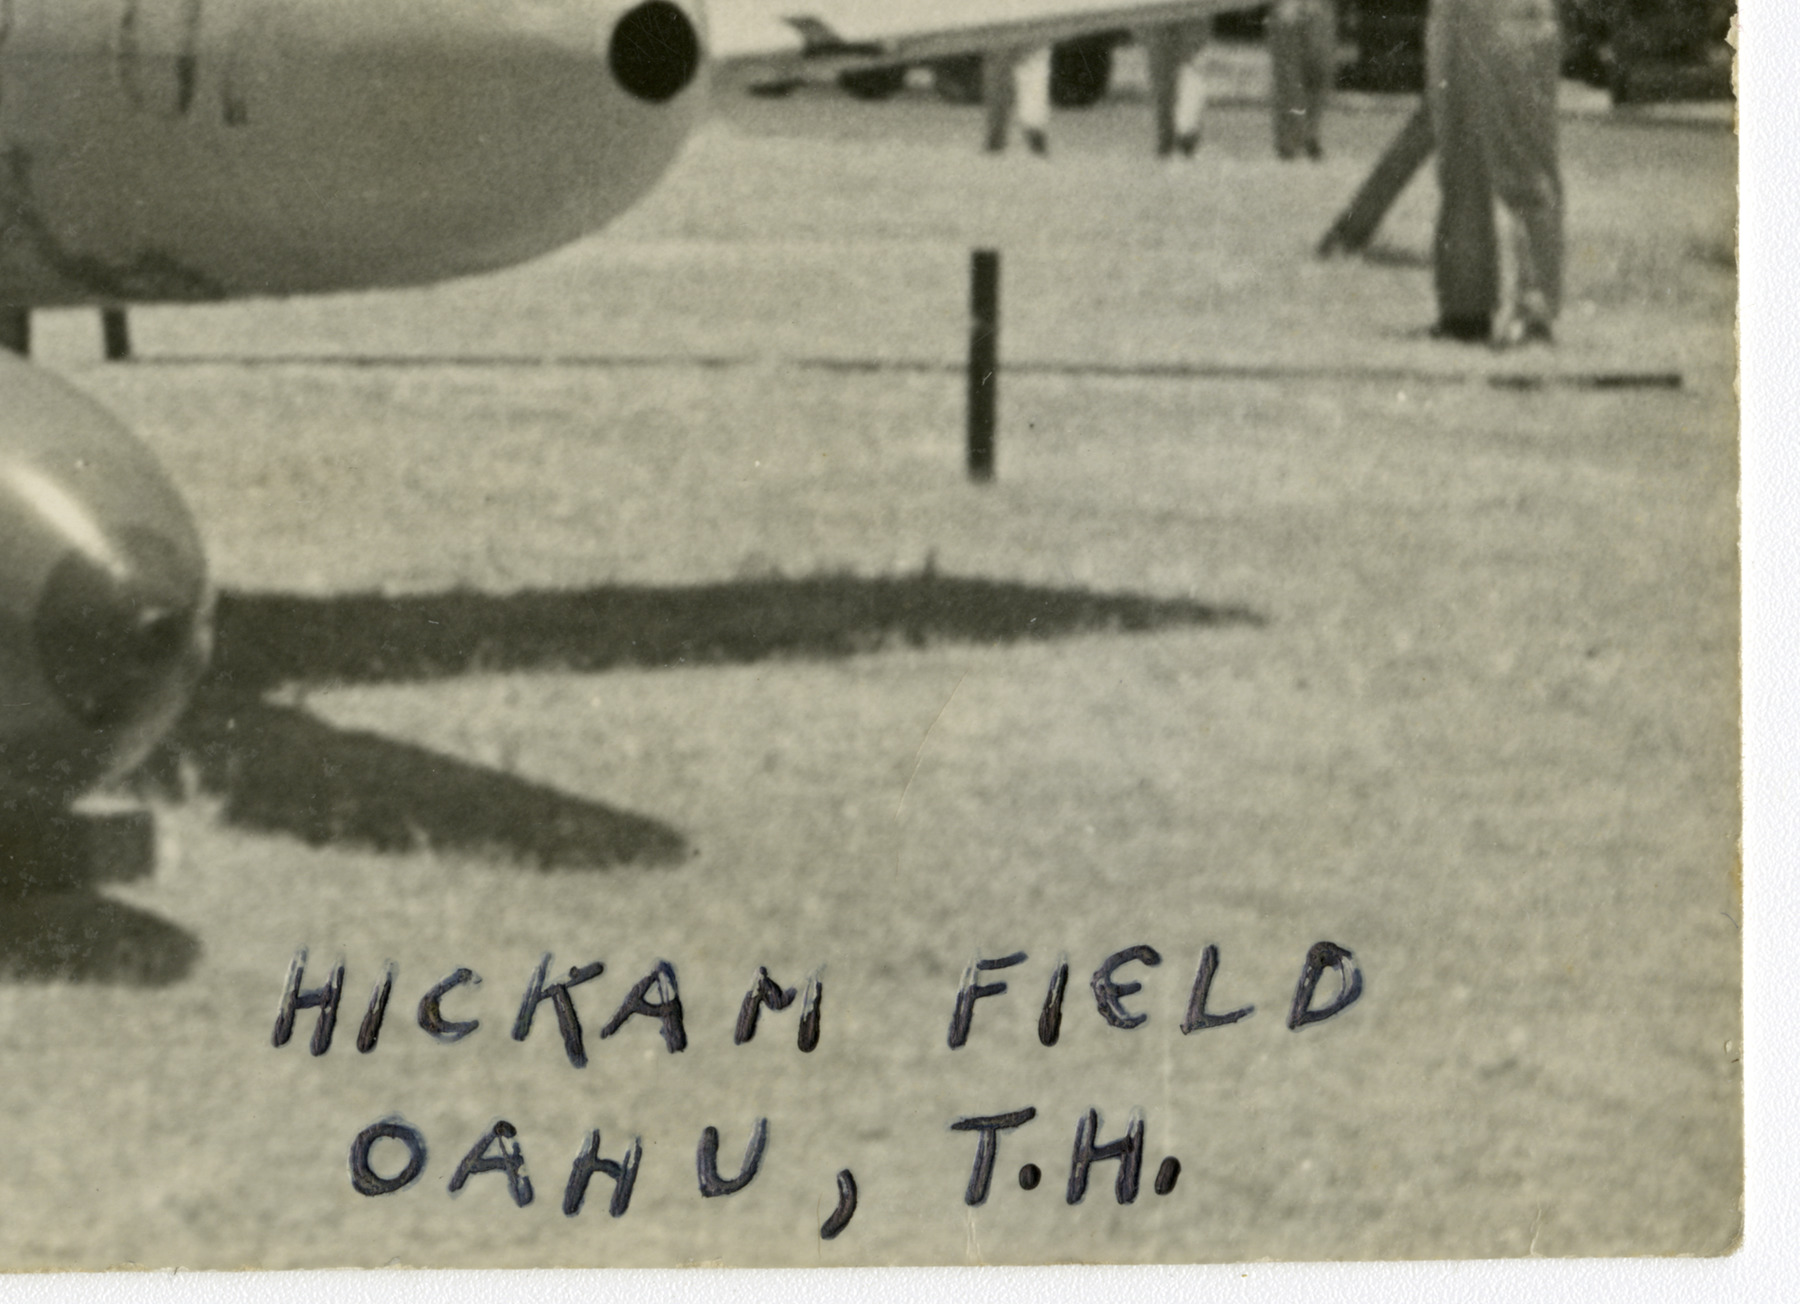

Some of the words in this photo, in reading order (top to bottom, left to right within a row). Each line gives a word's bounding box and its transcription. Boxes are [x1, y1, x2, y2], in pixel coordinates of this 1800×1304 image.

[273, 947, 825, 1068] HICKAM
[948, 942, 1363, 1049] FIELD
[349, 1114, 857, 1239] OAHU,
[951, 1107, 1181, 1205] T.H.
